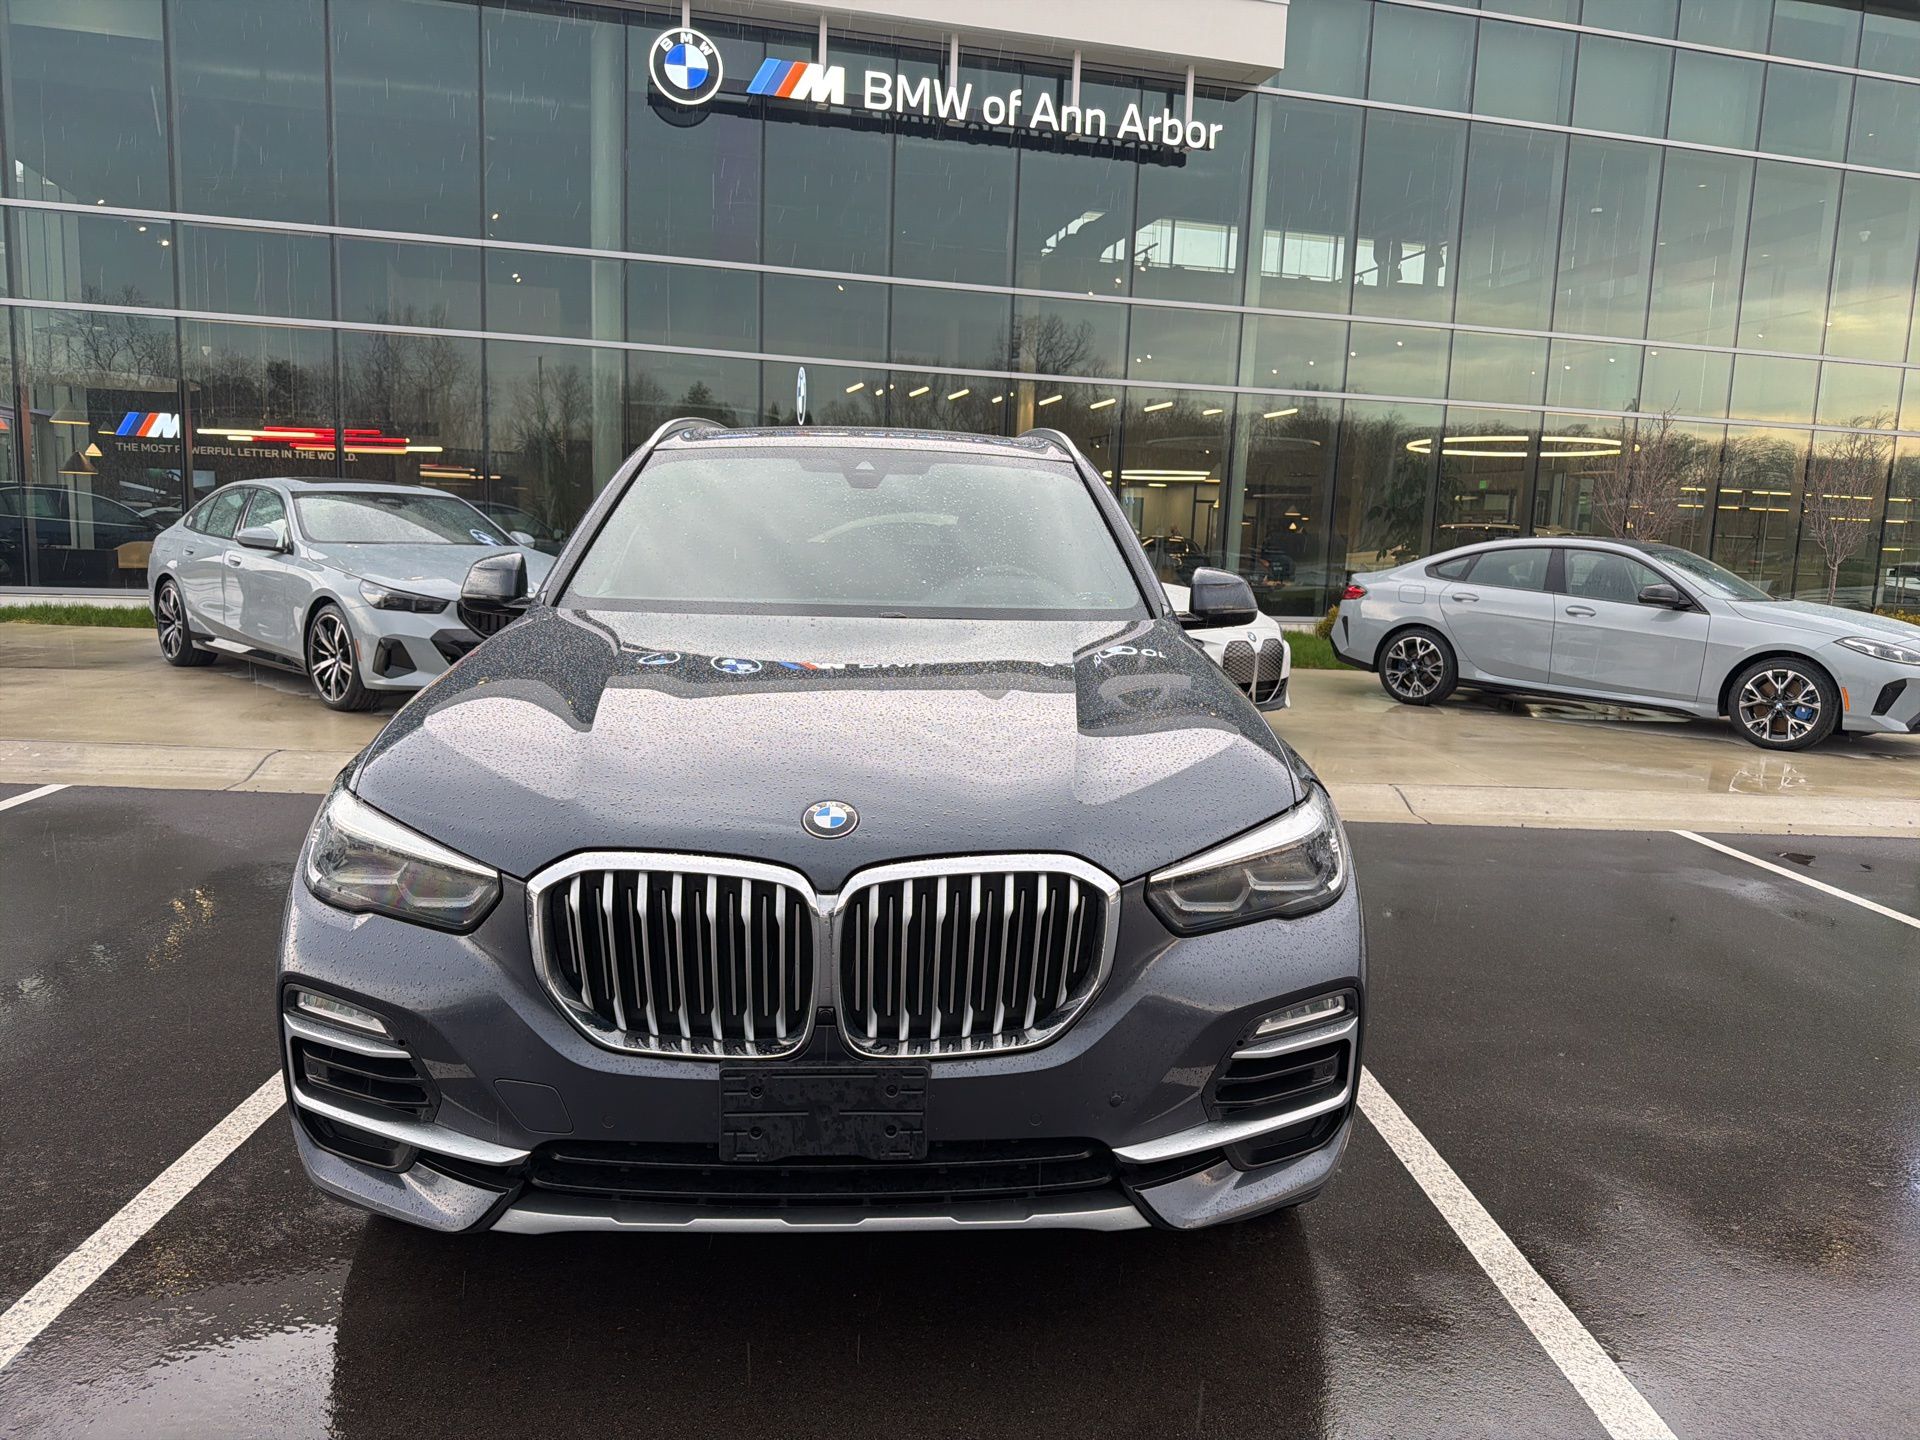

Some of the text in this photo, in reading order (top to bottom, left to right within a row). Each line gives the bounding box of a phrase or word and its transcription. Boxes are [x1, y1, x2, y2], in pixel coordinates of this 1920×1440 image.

[789, 62, 845, 105] M
[864, 70, 1224, 150] BMW of Ann Arbor
[115, 442, 138, 452] THE
[141, 443, 173, 454] MOST
[174, 445, 235, 456] PWERFUL
[237, 447, 279, 458] LETTER
[281, 449, 292, 459] IN
[294, 450, 316, 460] THE
